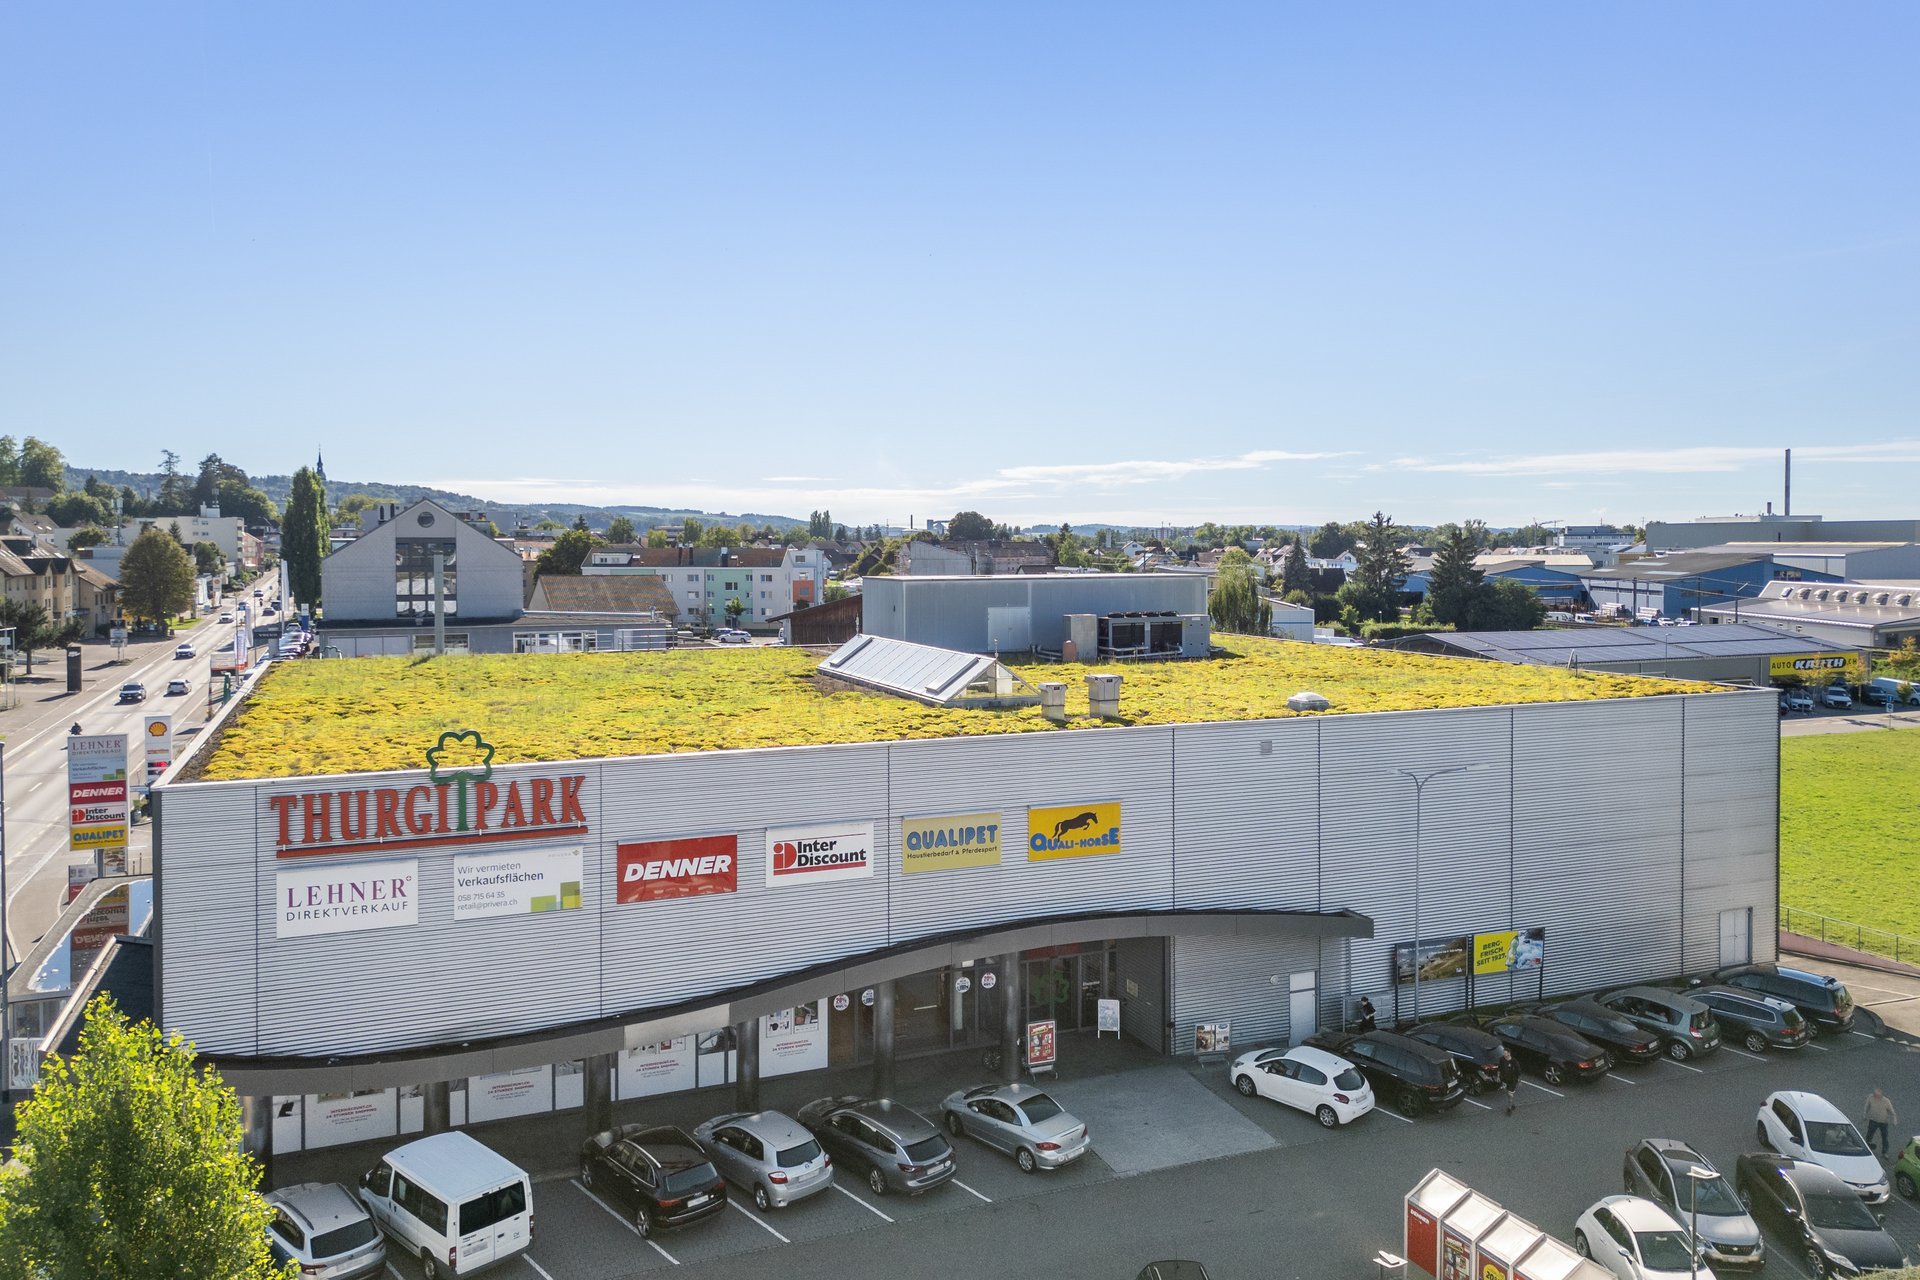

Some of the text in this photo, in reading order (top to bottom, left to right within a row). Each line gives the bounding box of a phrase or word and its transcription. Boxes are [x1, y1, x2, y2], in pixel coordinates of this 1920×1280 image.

[1771, 661, 1791, 669] AUTO
[72, 740, 121, 751] LEHNER
[72, 786, 124, 798] DENNER
[85, 807, 108, 815] Inter
[85, 812, 125, 820] Discount
[270, 775, 587, 846] THURGI PARK
[73, 829, 125, 842] QUALIPET
[906, 824, 998, 851] QUALIPET
[797, 839, 838, 854] Inter
[907, 849, 954, 860] Haustierbedarf
[961, 846, 998, 855] Pferdesport
[797, 848, 867, 868] Discount
[457, 862, 521, 875] Wir vermieten
[623, 854, 731, 883] DENNER
[457, 871, 544, 888] Verkaufsflächen
[287, 878, 408, 909] LEHNER
[457, 893, 471, 902] 058
[473, 892, 485, 900] 715
[286, 900, 408, 922] DIREKTVERKAUF
[457, 898, 518, 911] retail@privera.ch
[1482, 940, 1503, 950] BERG-
[1480, 946, 1504, 958] FRISCH
[1476, 957, 1490, 967] SEIT
